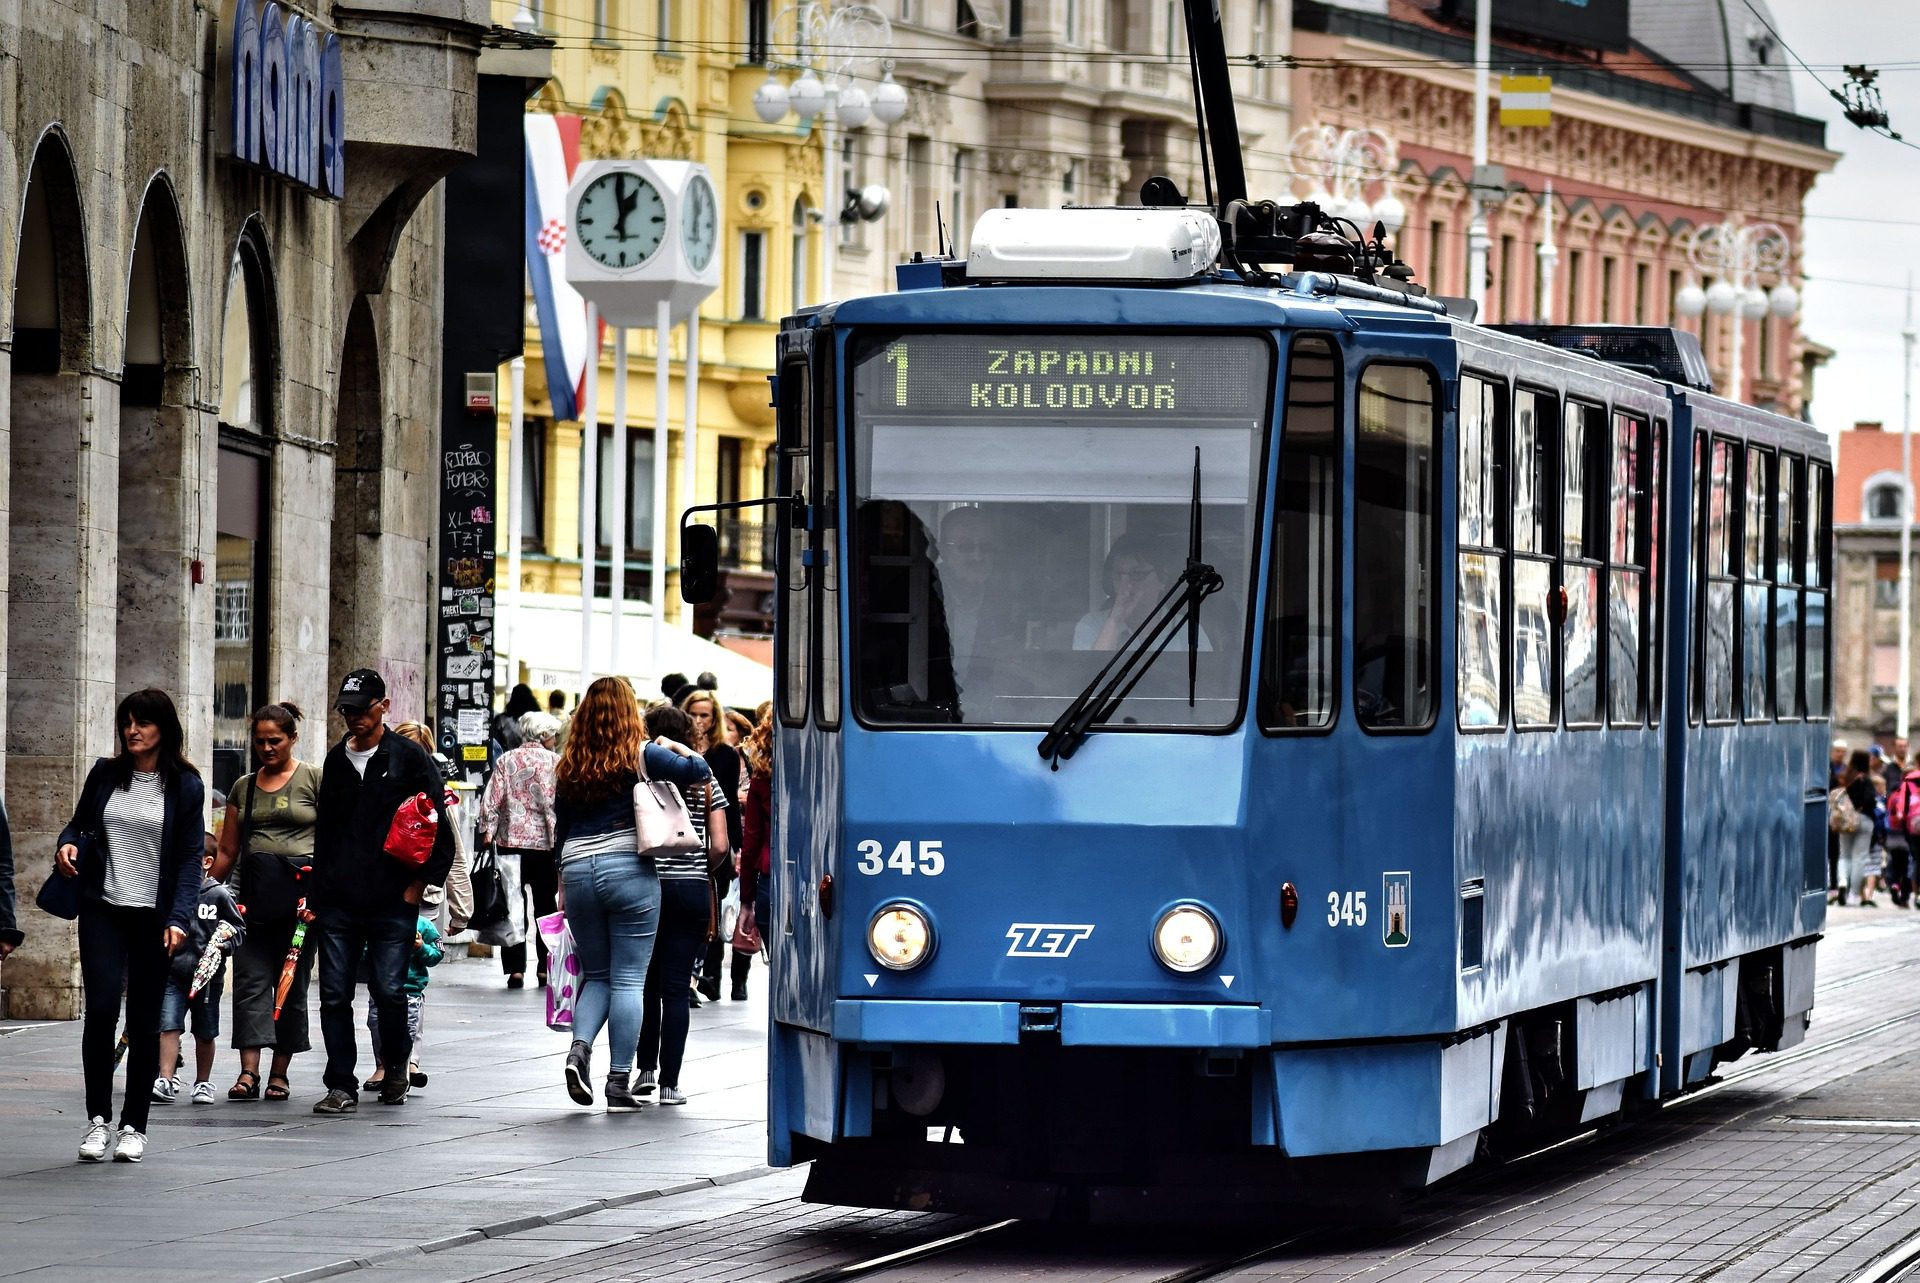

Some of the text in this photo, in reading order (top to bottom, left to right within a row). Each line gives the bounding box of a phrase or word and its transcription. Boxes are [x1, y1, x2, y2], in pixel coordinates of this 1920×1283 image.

[886, 343, 1154, 407] 1 ZAPADNI
[970, 383, 1175, 409] KOLODVOR
[856, 839, 945, 876] 345
[198, 904, 217, 920] 02
[1327, 891, 1367, 927] 345
[1005, 923, 1096, 958] ZET
